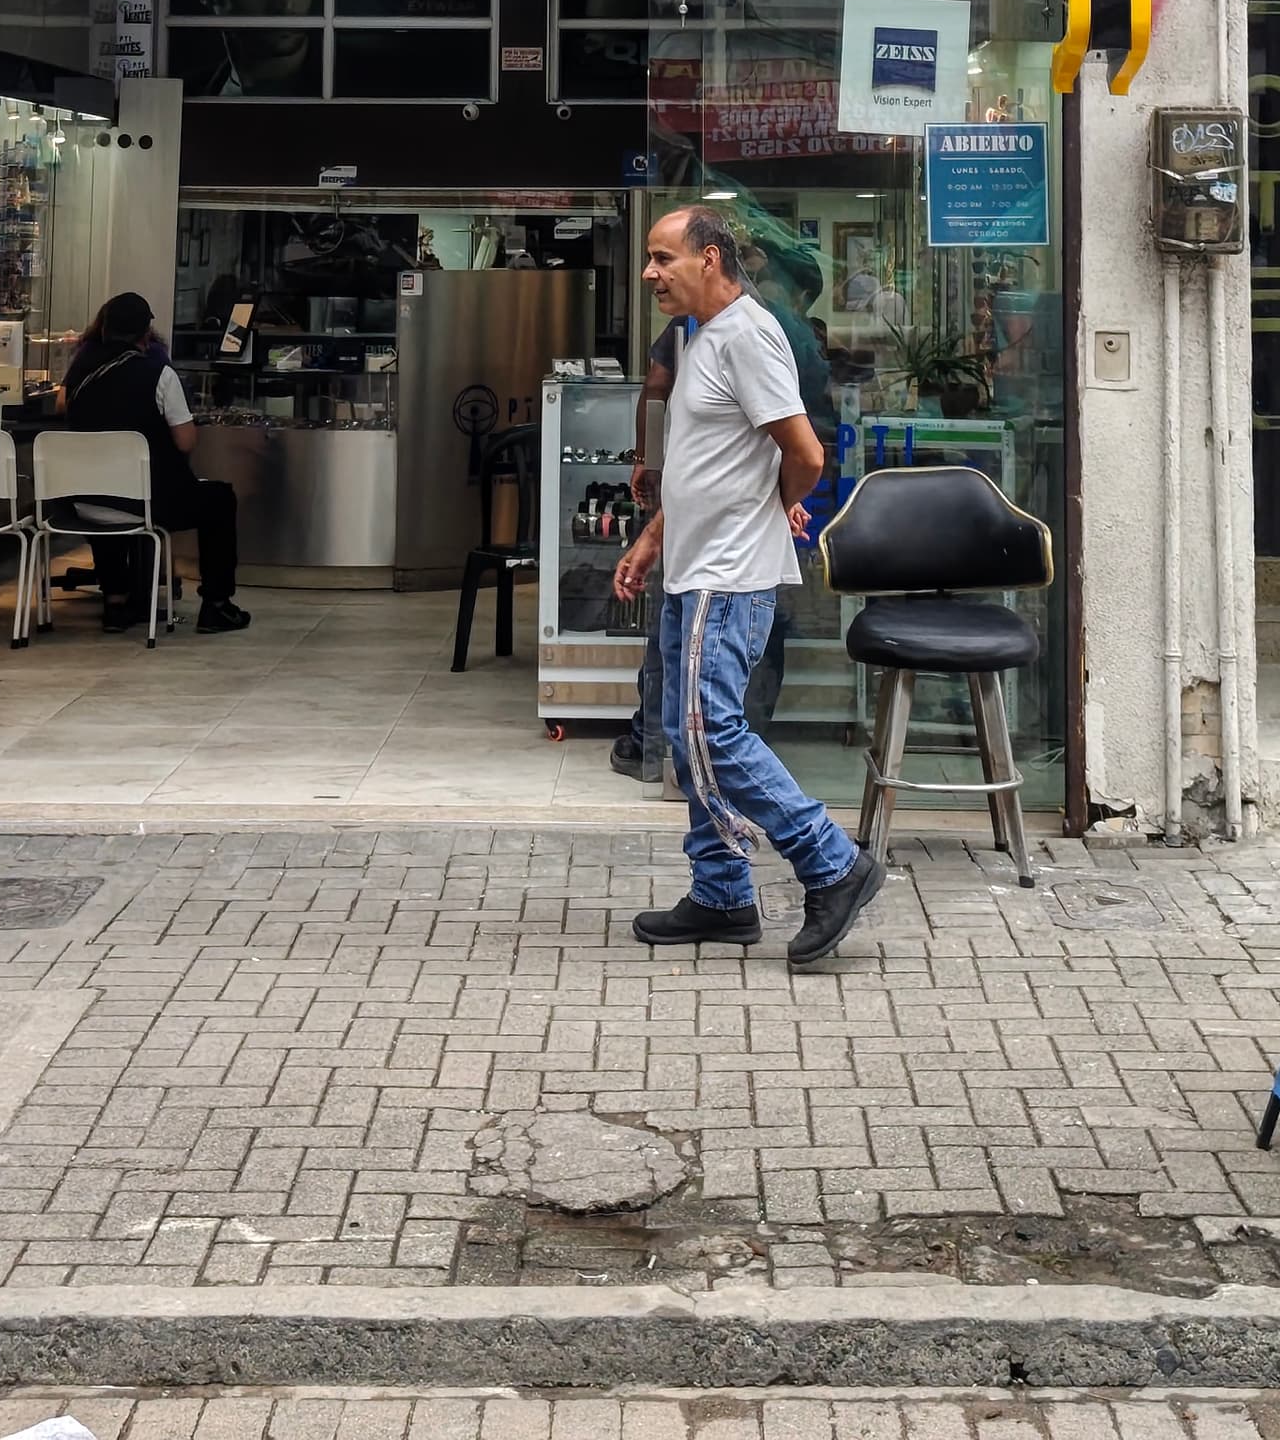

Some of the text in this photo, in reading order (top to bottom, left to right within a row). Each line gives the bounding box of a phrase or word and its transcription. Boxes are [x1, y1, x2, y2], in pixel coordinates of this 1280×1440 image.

[876, 43, 937, 61] ZEISS
[873, 95, 932, 110] Vision Expert
[939, 134, 1035, 153] ABIERTO
[951, 167, 979, 175] LUNES
